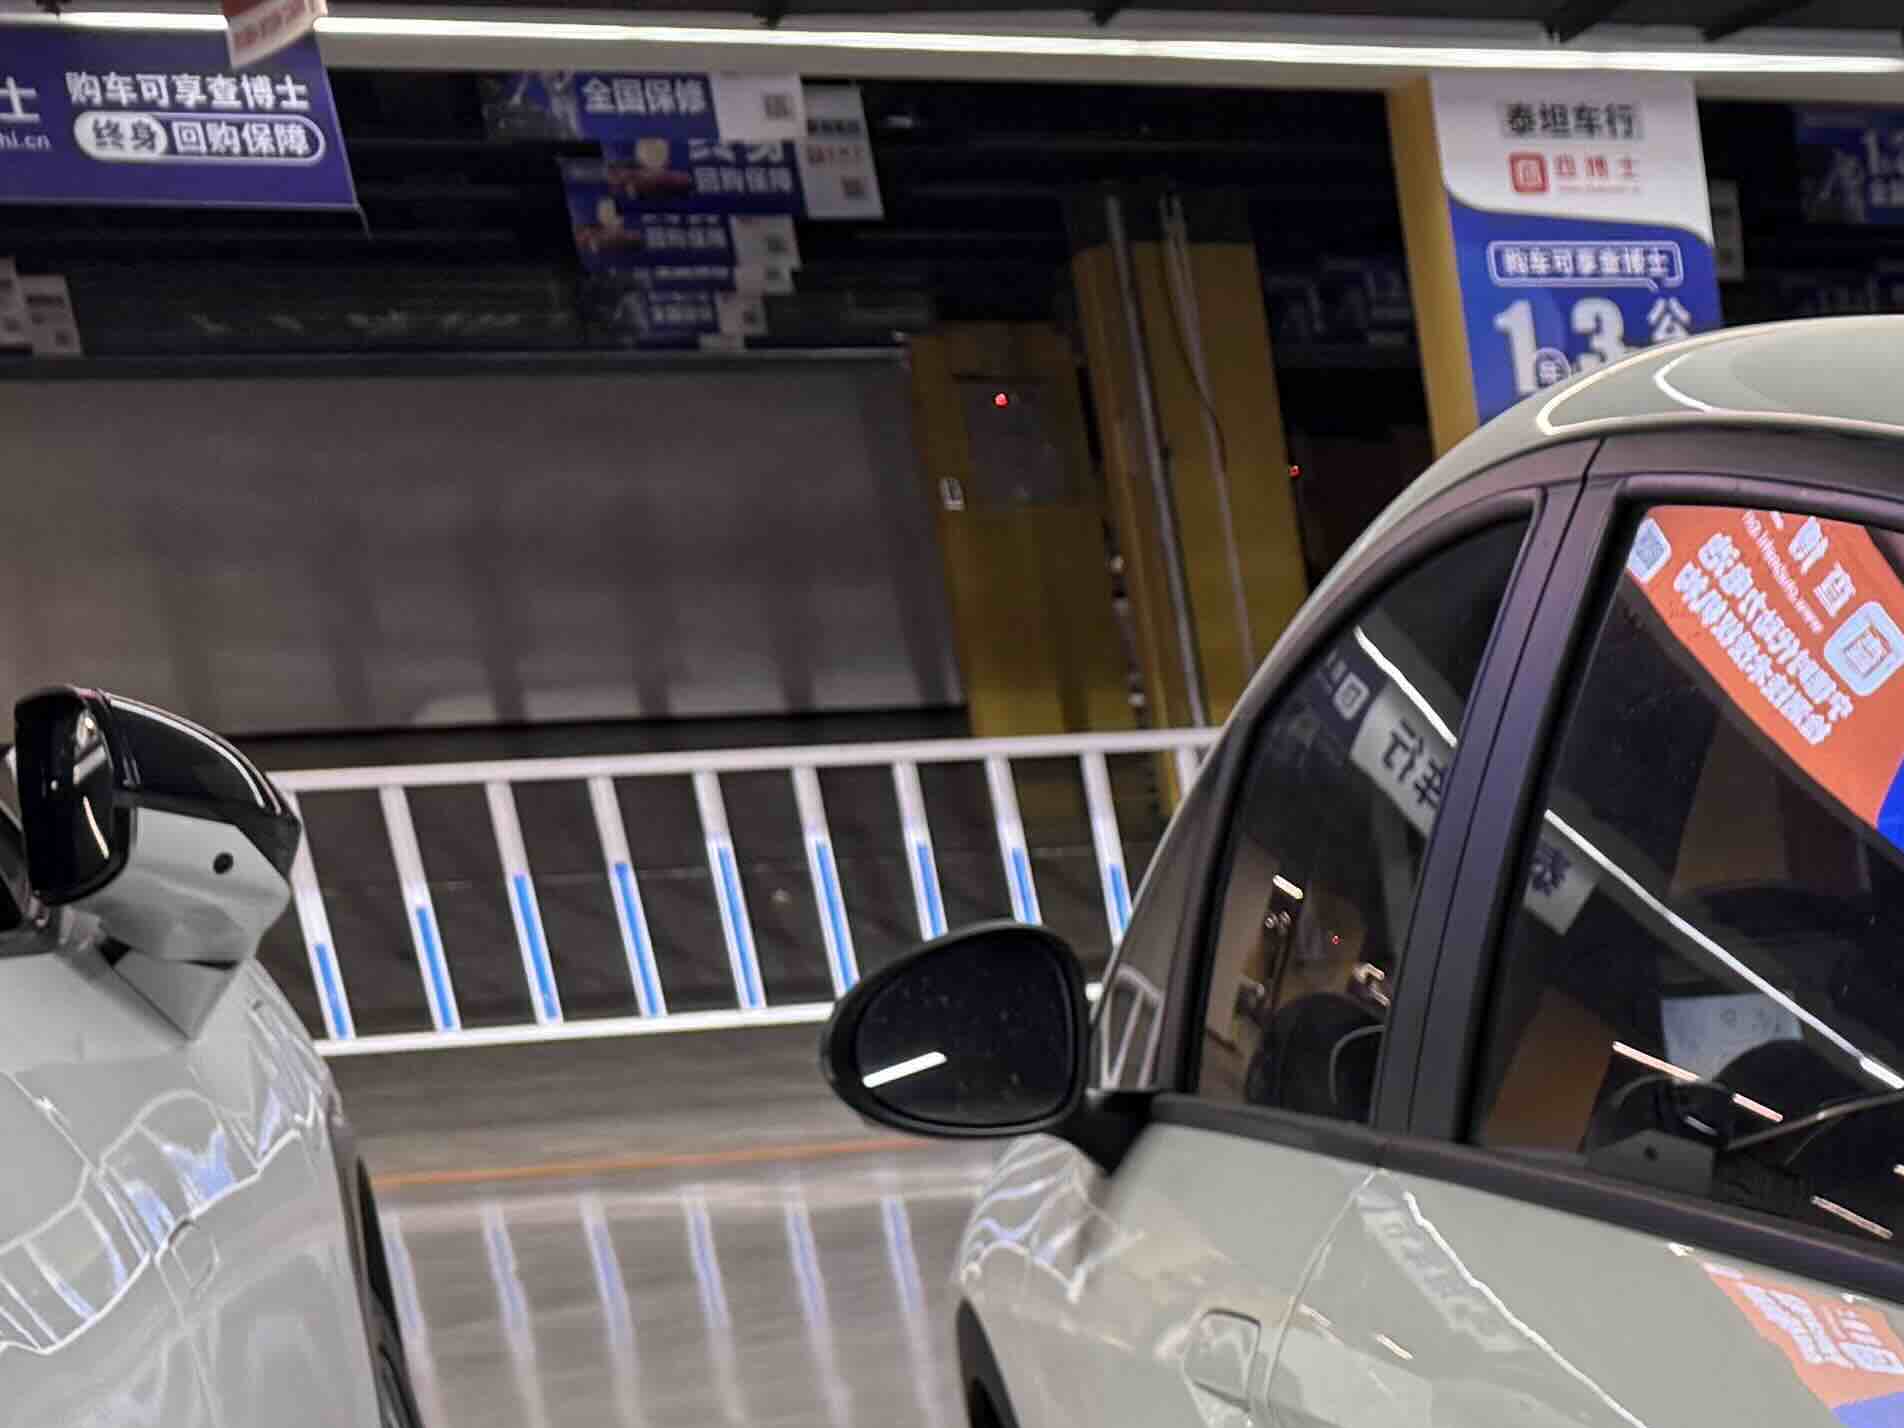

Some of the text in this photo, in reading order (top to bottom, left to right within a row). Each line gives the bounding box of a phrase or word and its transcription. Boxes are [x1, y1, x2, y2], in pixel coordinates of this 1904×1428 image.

[65, 71, 311, 111] 购车可享查博士
[582, 77, 708, 116] 全国保修
[92, 117, 311, 156] 终身 回购保障
[1506, 103, 1636, 140] 泰坦车行
